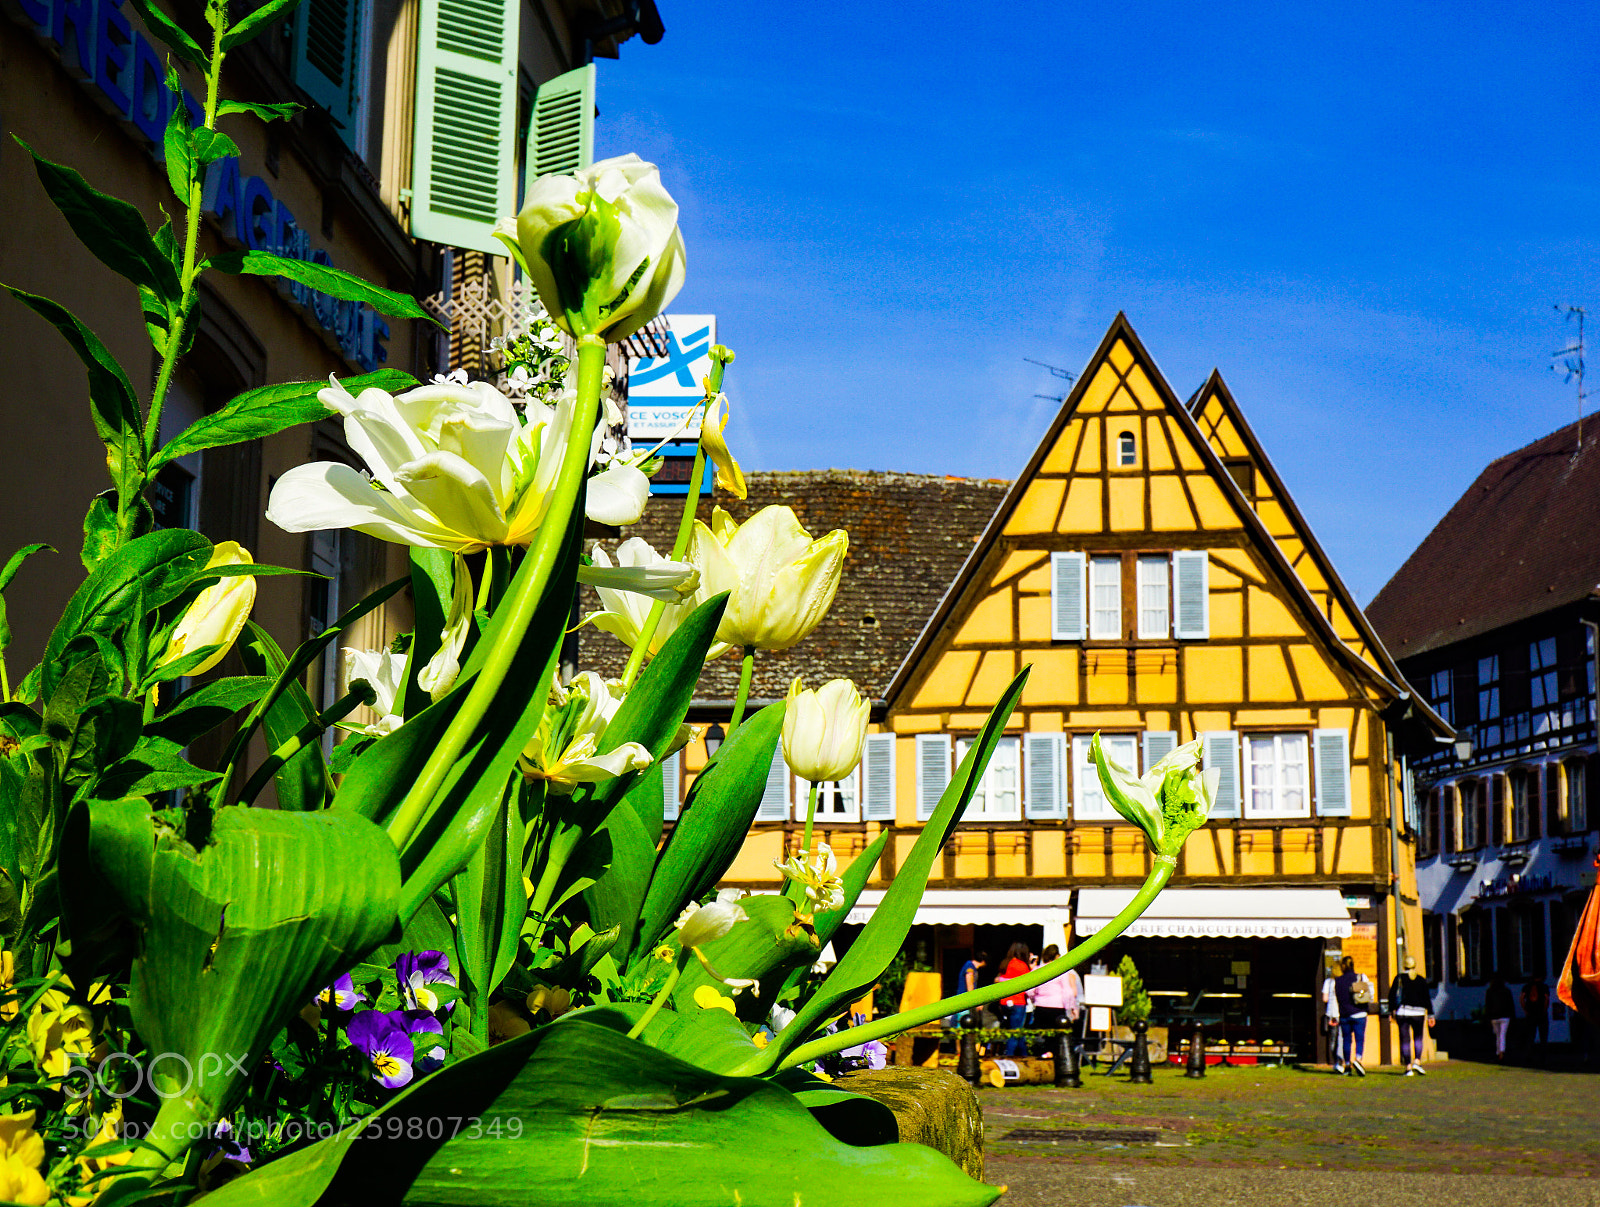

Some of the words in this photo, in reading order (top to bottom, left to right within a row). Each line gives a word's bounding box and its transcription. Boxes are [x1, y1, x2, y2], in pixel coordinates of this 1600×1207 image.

[1085, 925, 1165, 934] BOERIE
[1168, 925, 1268, 934] CHARCUTERIE
[1272, 926, 1344, 935] TRAITEUR
